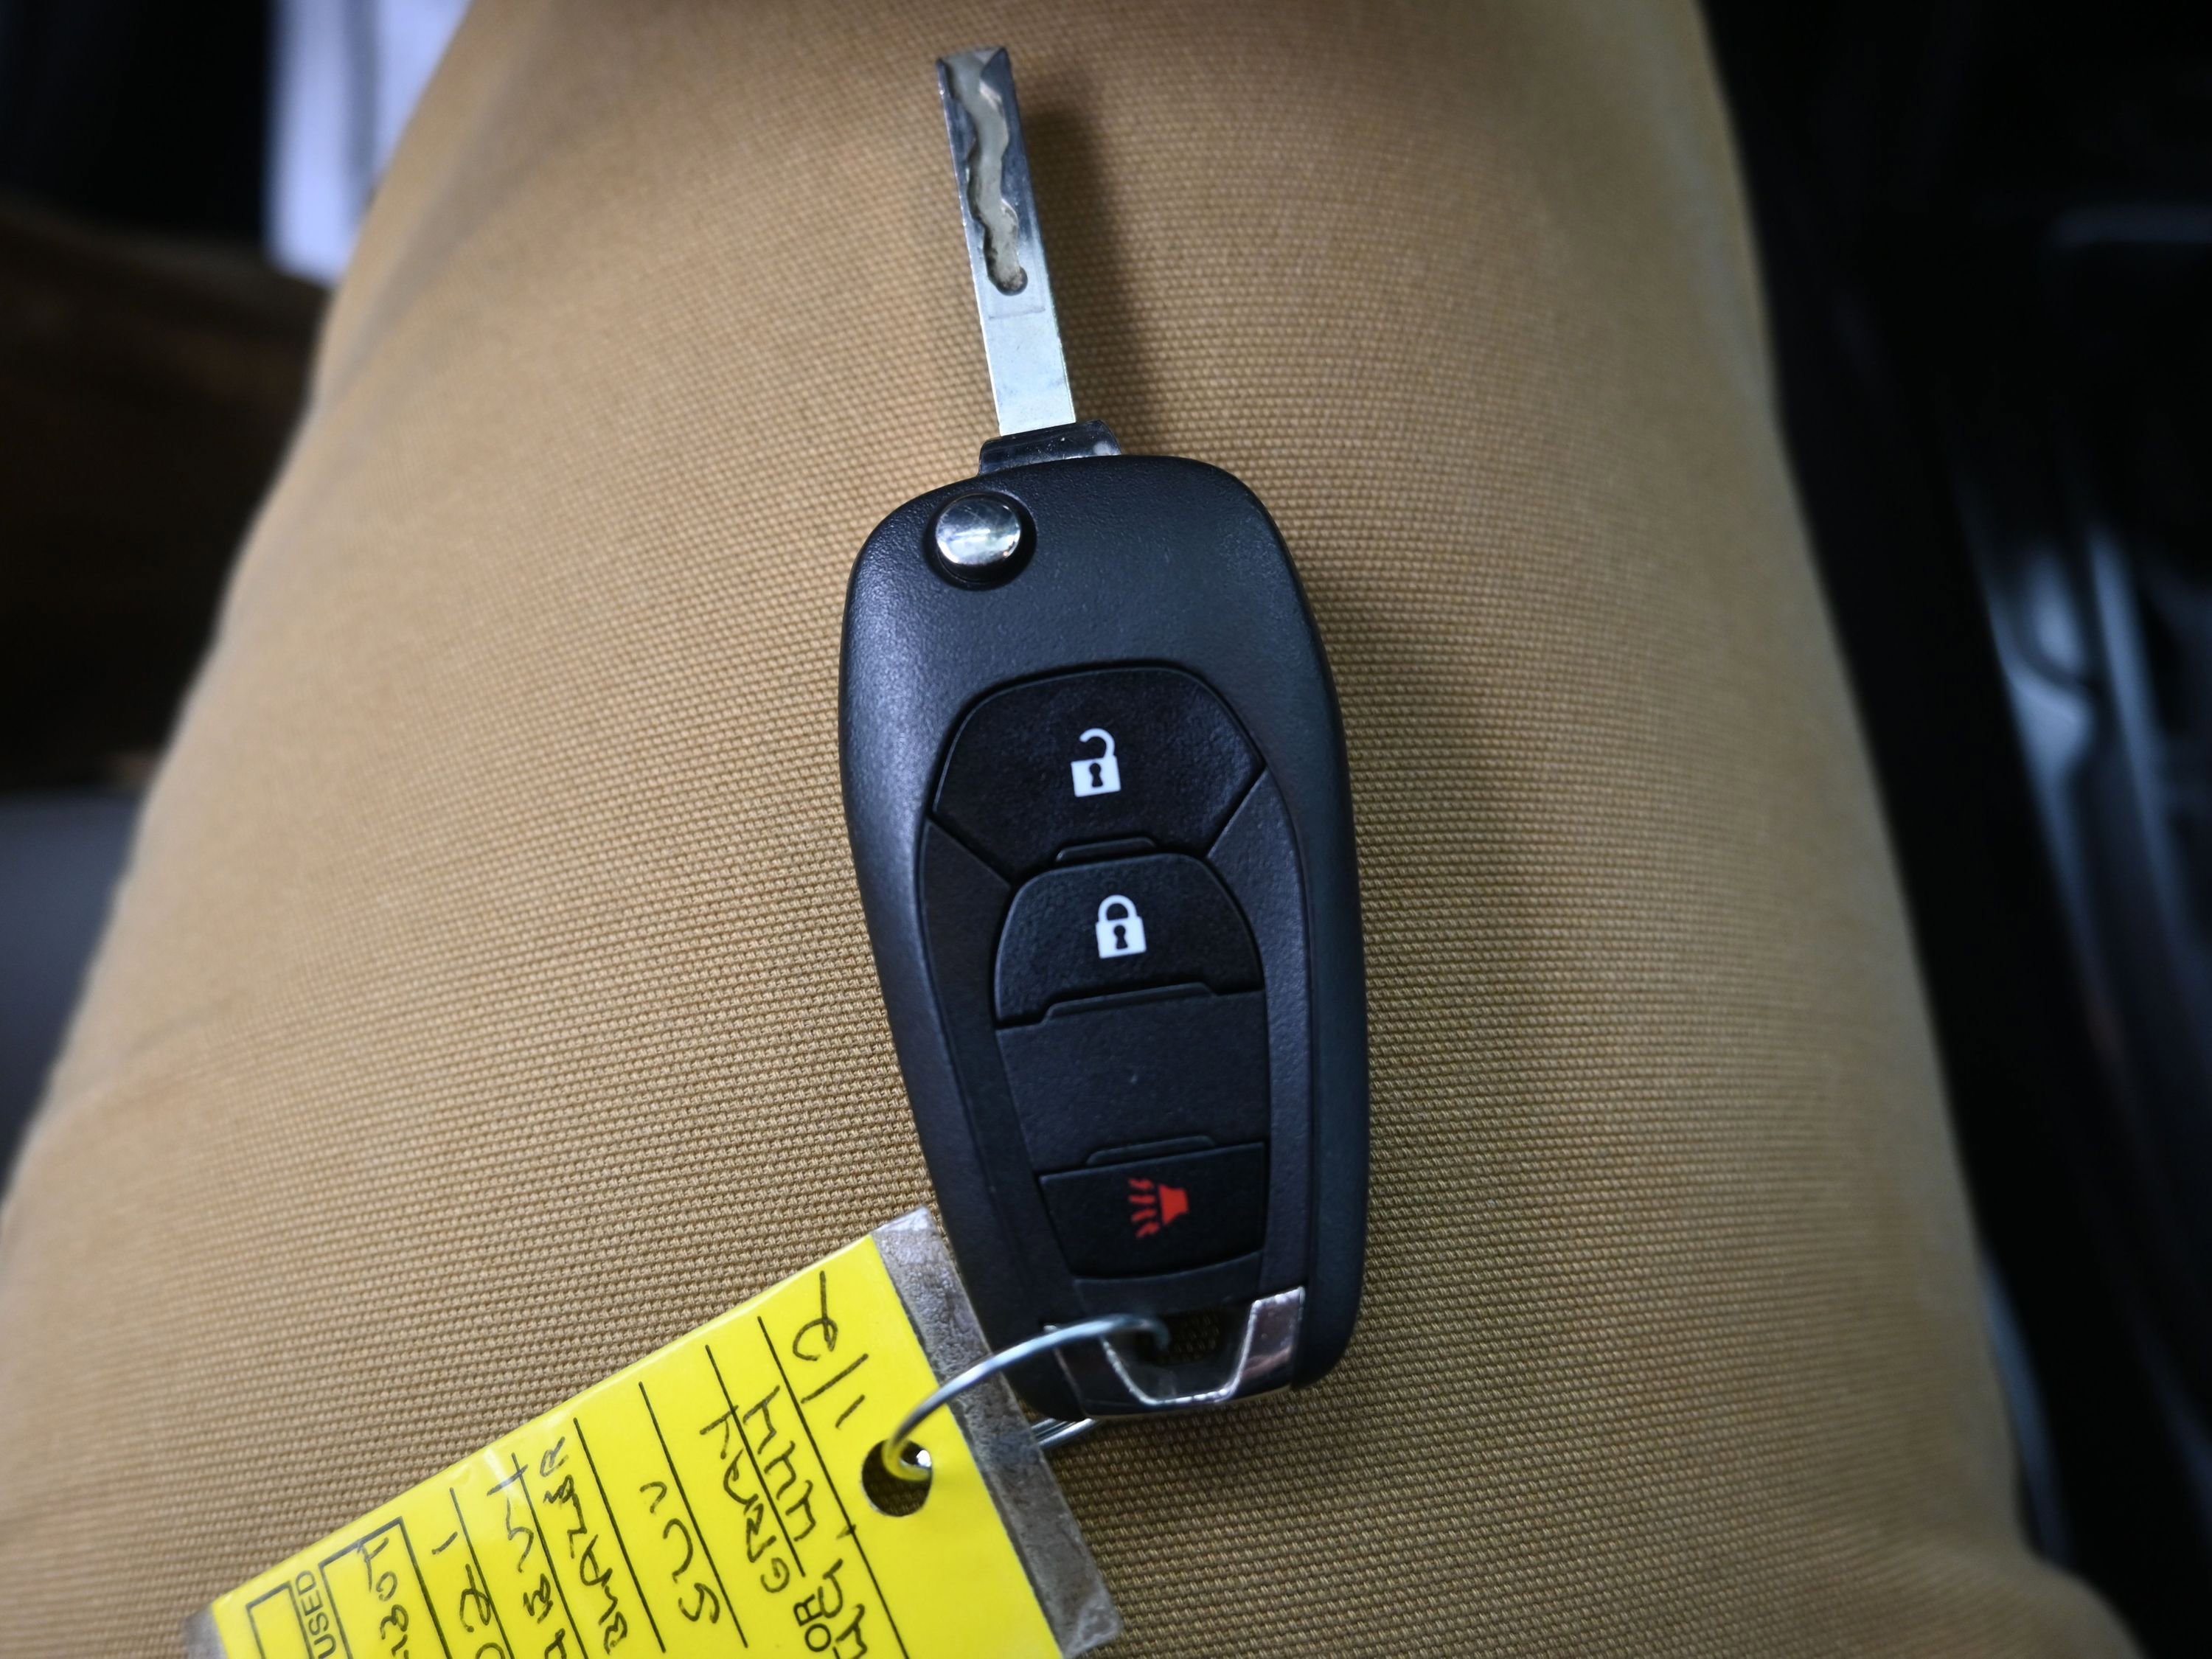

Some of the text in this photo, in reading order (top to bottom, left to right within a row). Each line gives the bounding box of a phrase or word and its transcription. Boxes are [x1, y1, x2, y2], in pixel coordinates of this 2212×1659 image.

[793, 1270, 869, 1430] 1/2
[539, 1436, 627, 1655] BLAZER
[639, 1481, 720, 1624] SUV
[700, 1404, 840, 1659] OR GRAY
[295, 1570, 337, 1659] USED
